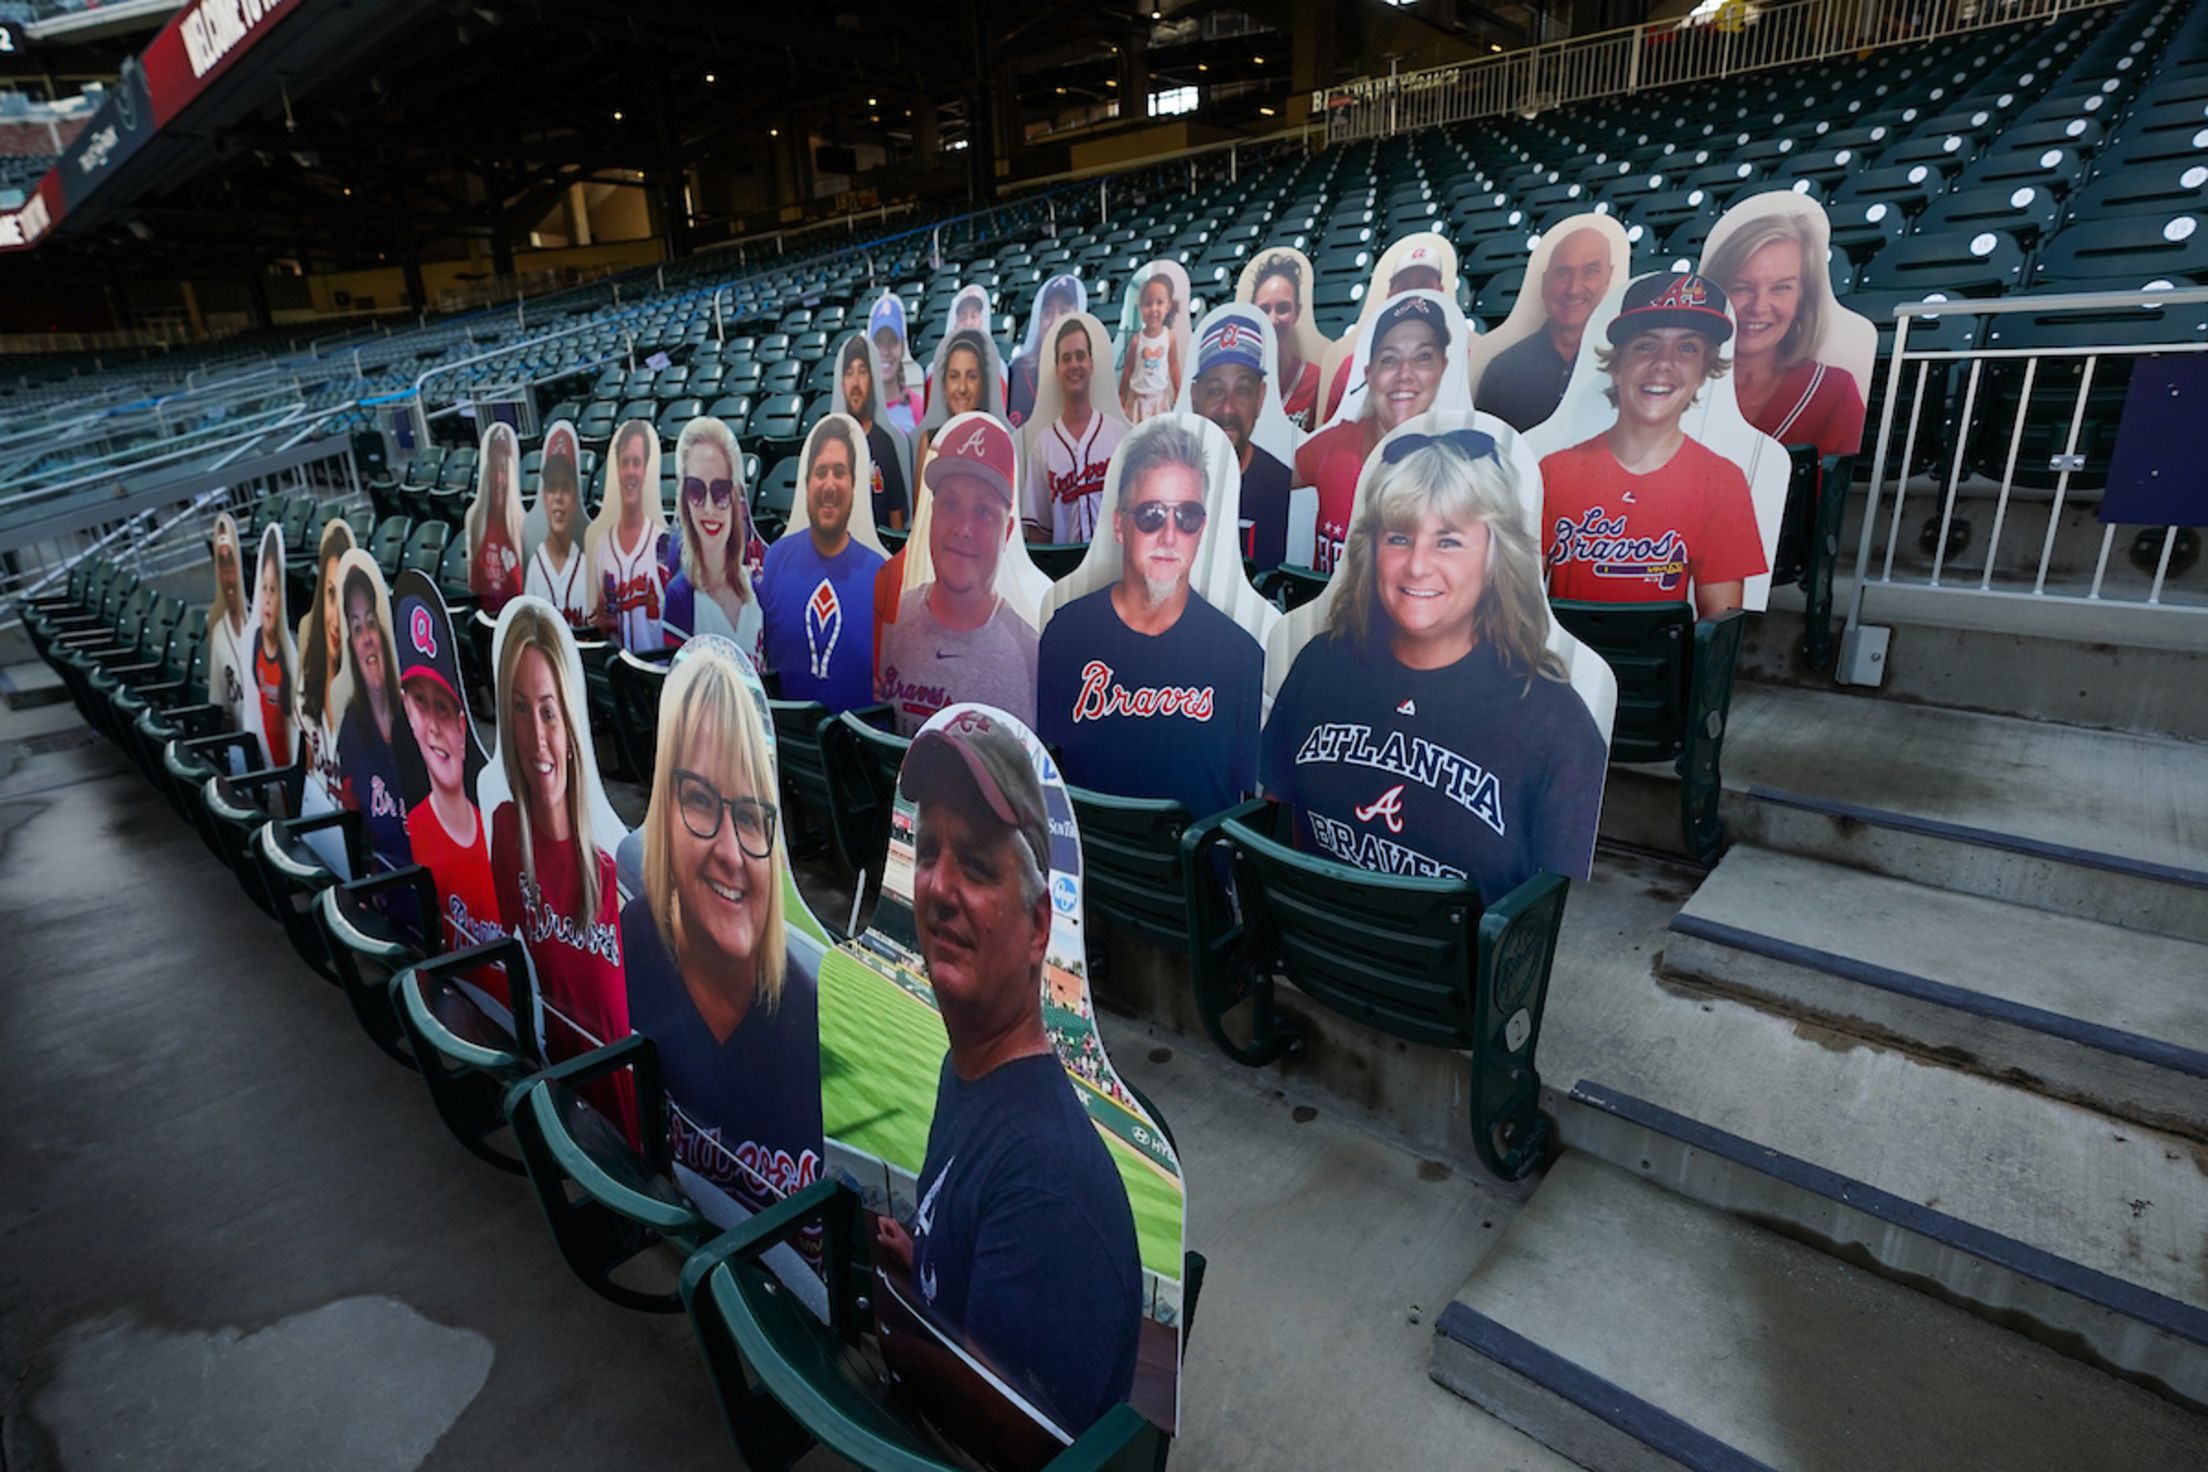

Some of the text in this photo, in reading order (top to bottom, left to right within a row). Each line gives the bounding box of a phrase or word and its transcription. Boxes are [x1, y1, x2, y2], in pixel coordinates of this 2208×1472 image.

[956, 426, 987, 457] A
[1551, 516, 1679, 566] Bravos
[1575, 506, 1628, 536] Los
[1072, 660, 1215, 724] Braves
[1295, 723, 1506, 837] ATLANTA
[1354, 784, 1406, 833] A
